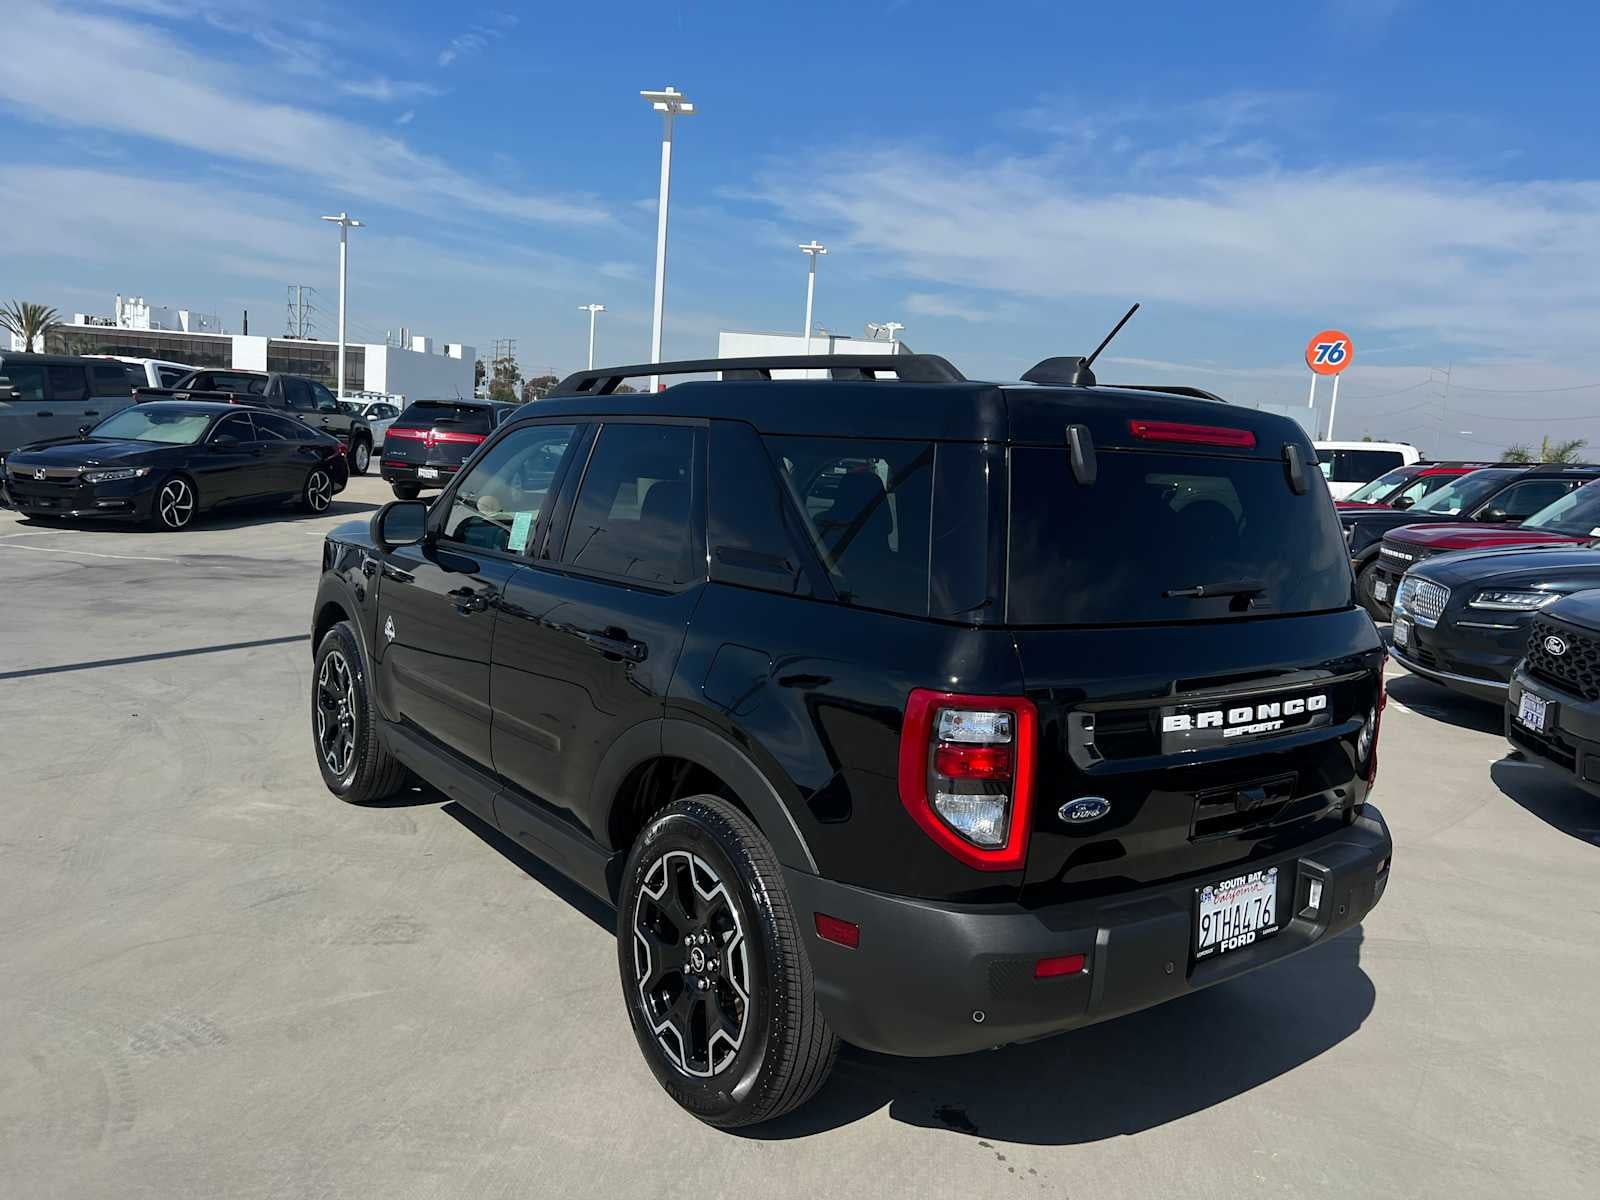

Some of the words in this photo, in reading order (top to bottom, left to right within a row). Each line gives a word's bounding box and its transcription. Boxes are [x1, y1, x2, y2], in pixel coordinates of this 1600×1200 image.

[1313, 340, 1347, 365] 76
[1162, 695, 1327, 732] BRONCO
[1223, 720, 1284, 738] SPORT
[1219, 875, 1246, 892] SOUTH
[1247, 871, 1263, 883] BAY
[1199, 894, 1272, 949] 9THA476
[1220, 931, 1256, 953] FORD
